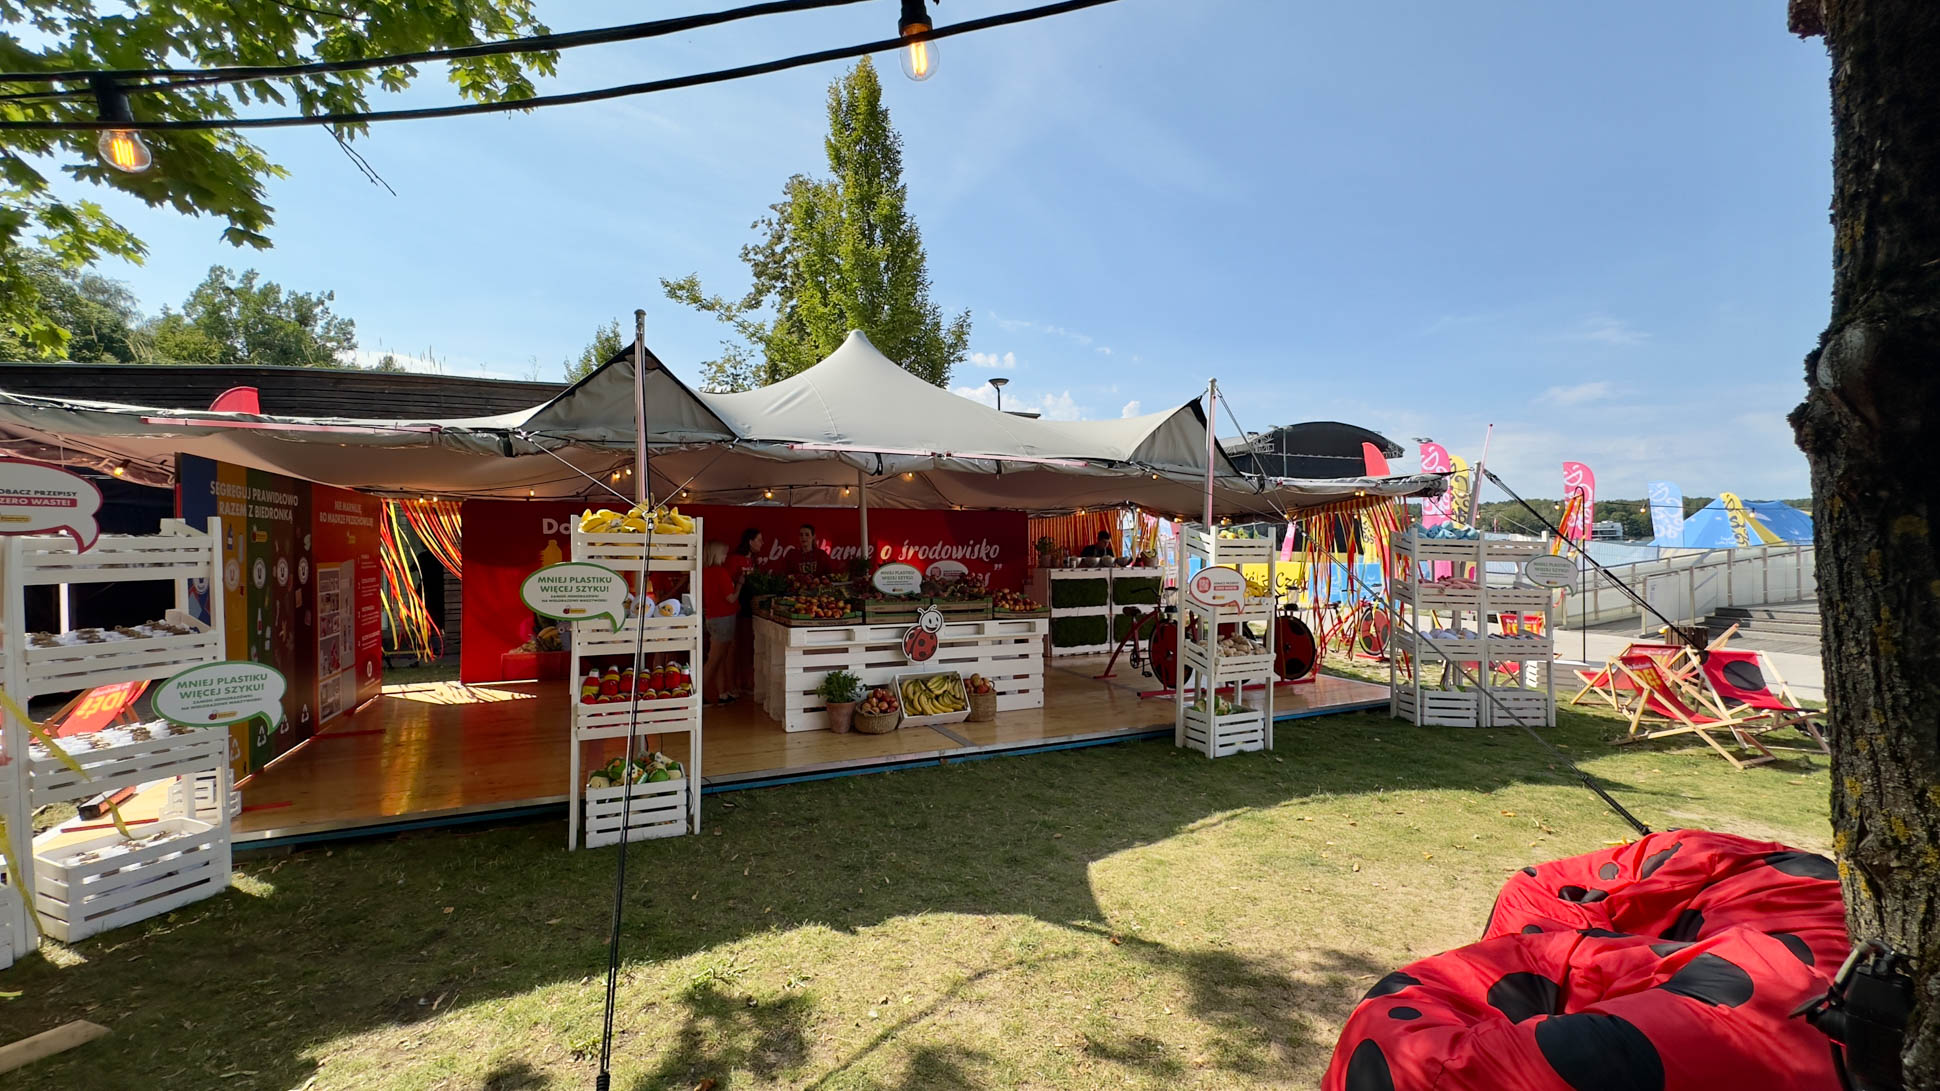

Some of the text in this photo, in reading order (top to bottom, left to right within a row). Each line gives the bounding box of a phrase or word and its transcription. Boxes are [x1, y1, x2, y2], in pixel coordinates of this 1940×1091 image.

[210, 480, 299, 506] SEGREGUJ PRAWIDŁOWO
[31, 498, 71, 506] WASTE!
[219, 501, 293, 524] RAZEM Z BIEDRONKĄ
[880, 544, 892, 560] o
[898, 539, 1000, 562] środowisko
[538, 576, 612, 584] MNIEJ PLASTIKU
[540, 585, 609, 593] WIĘCEJ SZYKU!
[176, 673, 268, 689] MNIEJ PLASTIKU
[179, 683, 265, 700] WIĘCEJ SZYKU!
